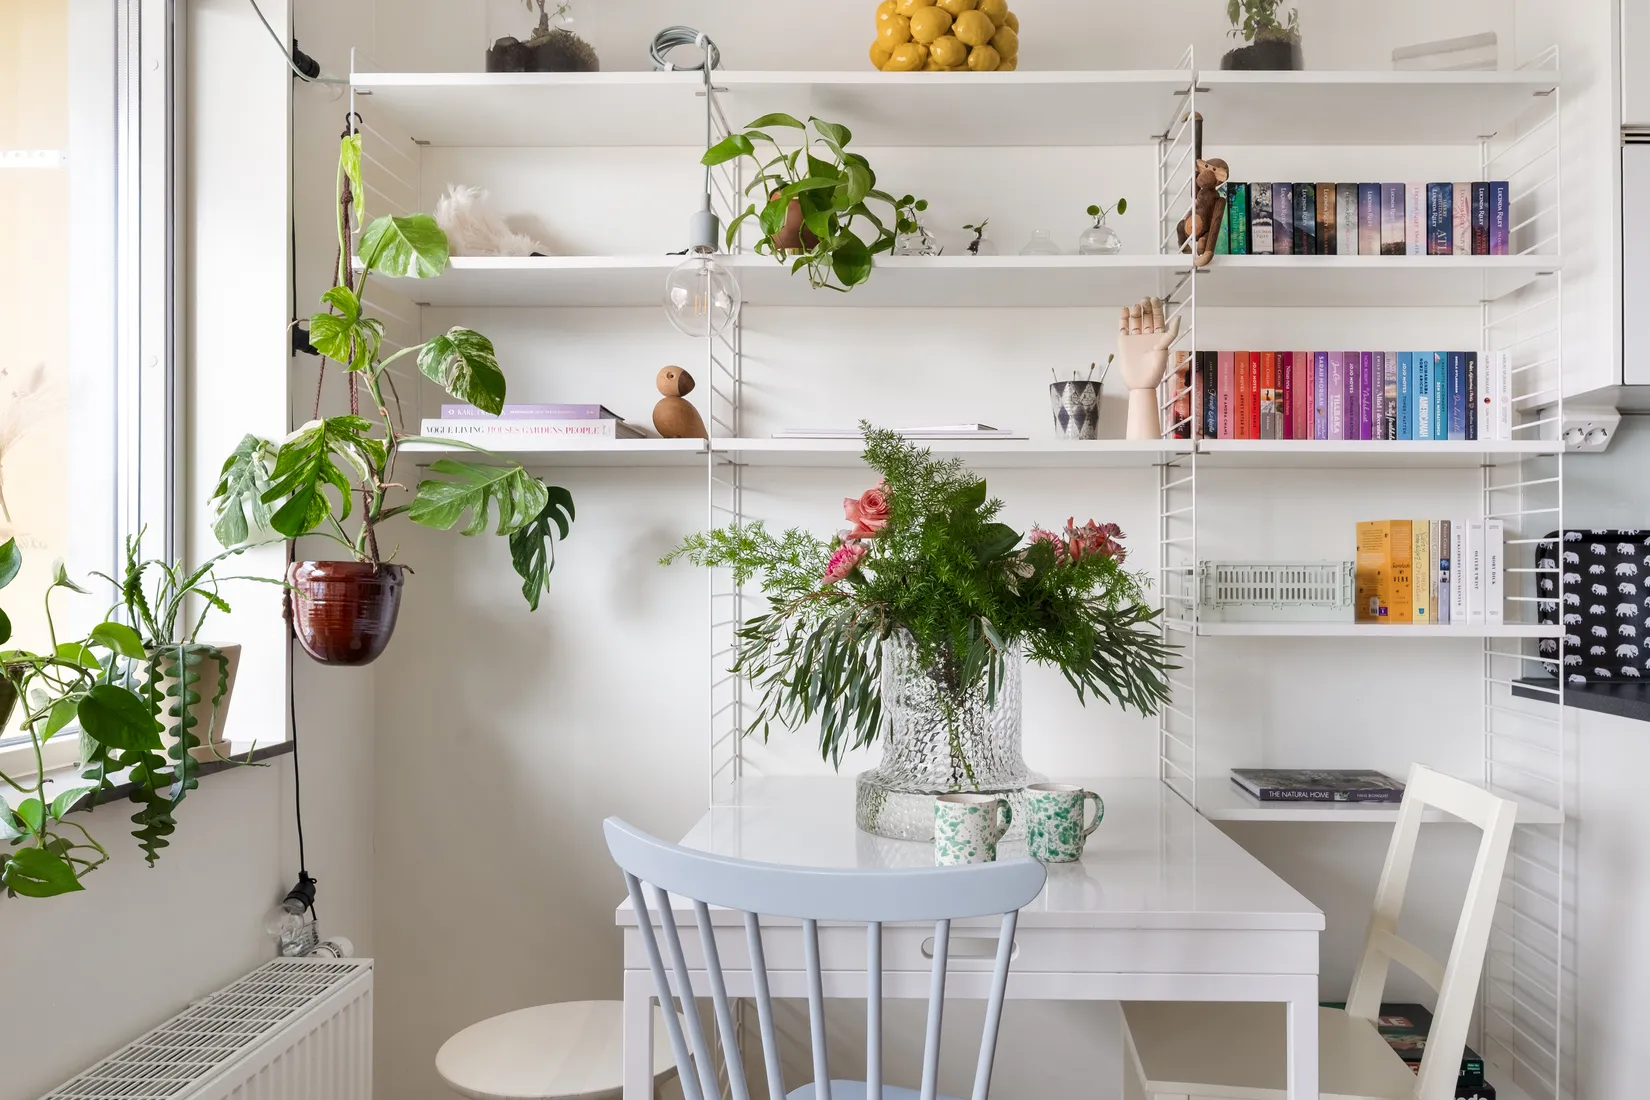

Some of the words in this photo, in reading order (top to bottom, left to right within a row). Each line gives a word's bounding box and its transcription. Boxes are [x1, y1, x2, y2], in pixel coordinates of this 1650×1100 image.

[1437, 230, 1447, 255] ATL
[1333, 394, 1341, 434] TILLBAKA
[1419, 396, 1428, 437] AMERICANAH
[426, 426, 454, 434] VOGUE
[455, 426, 484, 434] LIVING
[521, 426, 563, 434] GARDENS
[565, 426, 599, 434] PEOPLE
[1310, 791, 1330, 799] HOME
